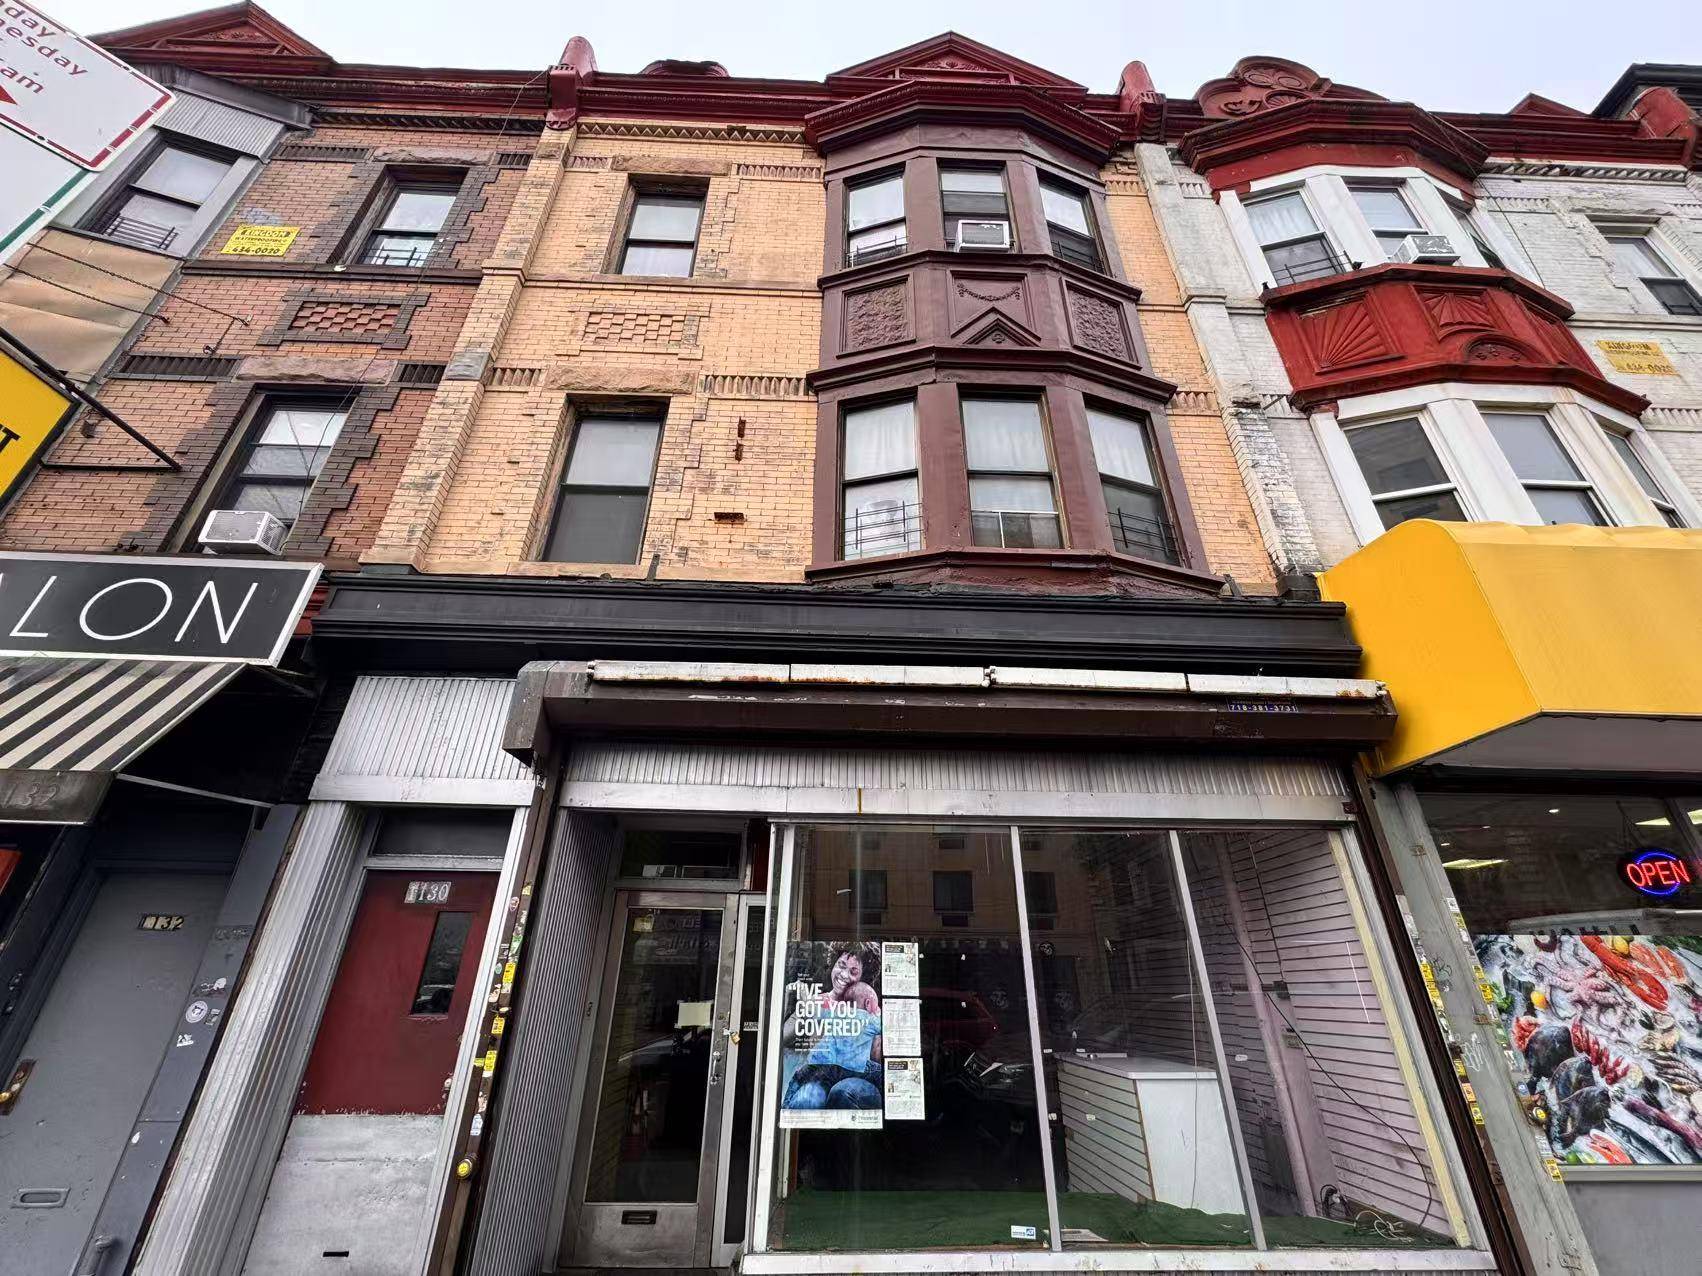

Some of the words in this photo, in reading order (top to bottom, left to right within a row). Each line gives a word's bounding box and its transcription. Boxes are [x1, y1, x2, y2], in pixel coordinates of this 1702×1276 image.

[0, 573, 258, 644] LON
[1627, 860, 1690, 887] OPEN
[406, 882, 450, 901] 1130
[795, 1001, 824, 1018] GOT
[828, 1001, 857, 1018] YOU
[795, 1019, 869, 1037] COVERED”
